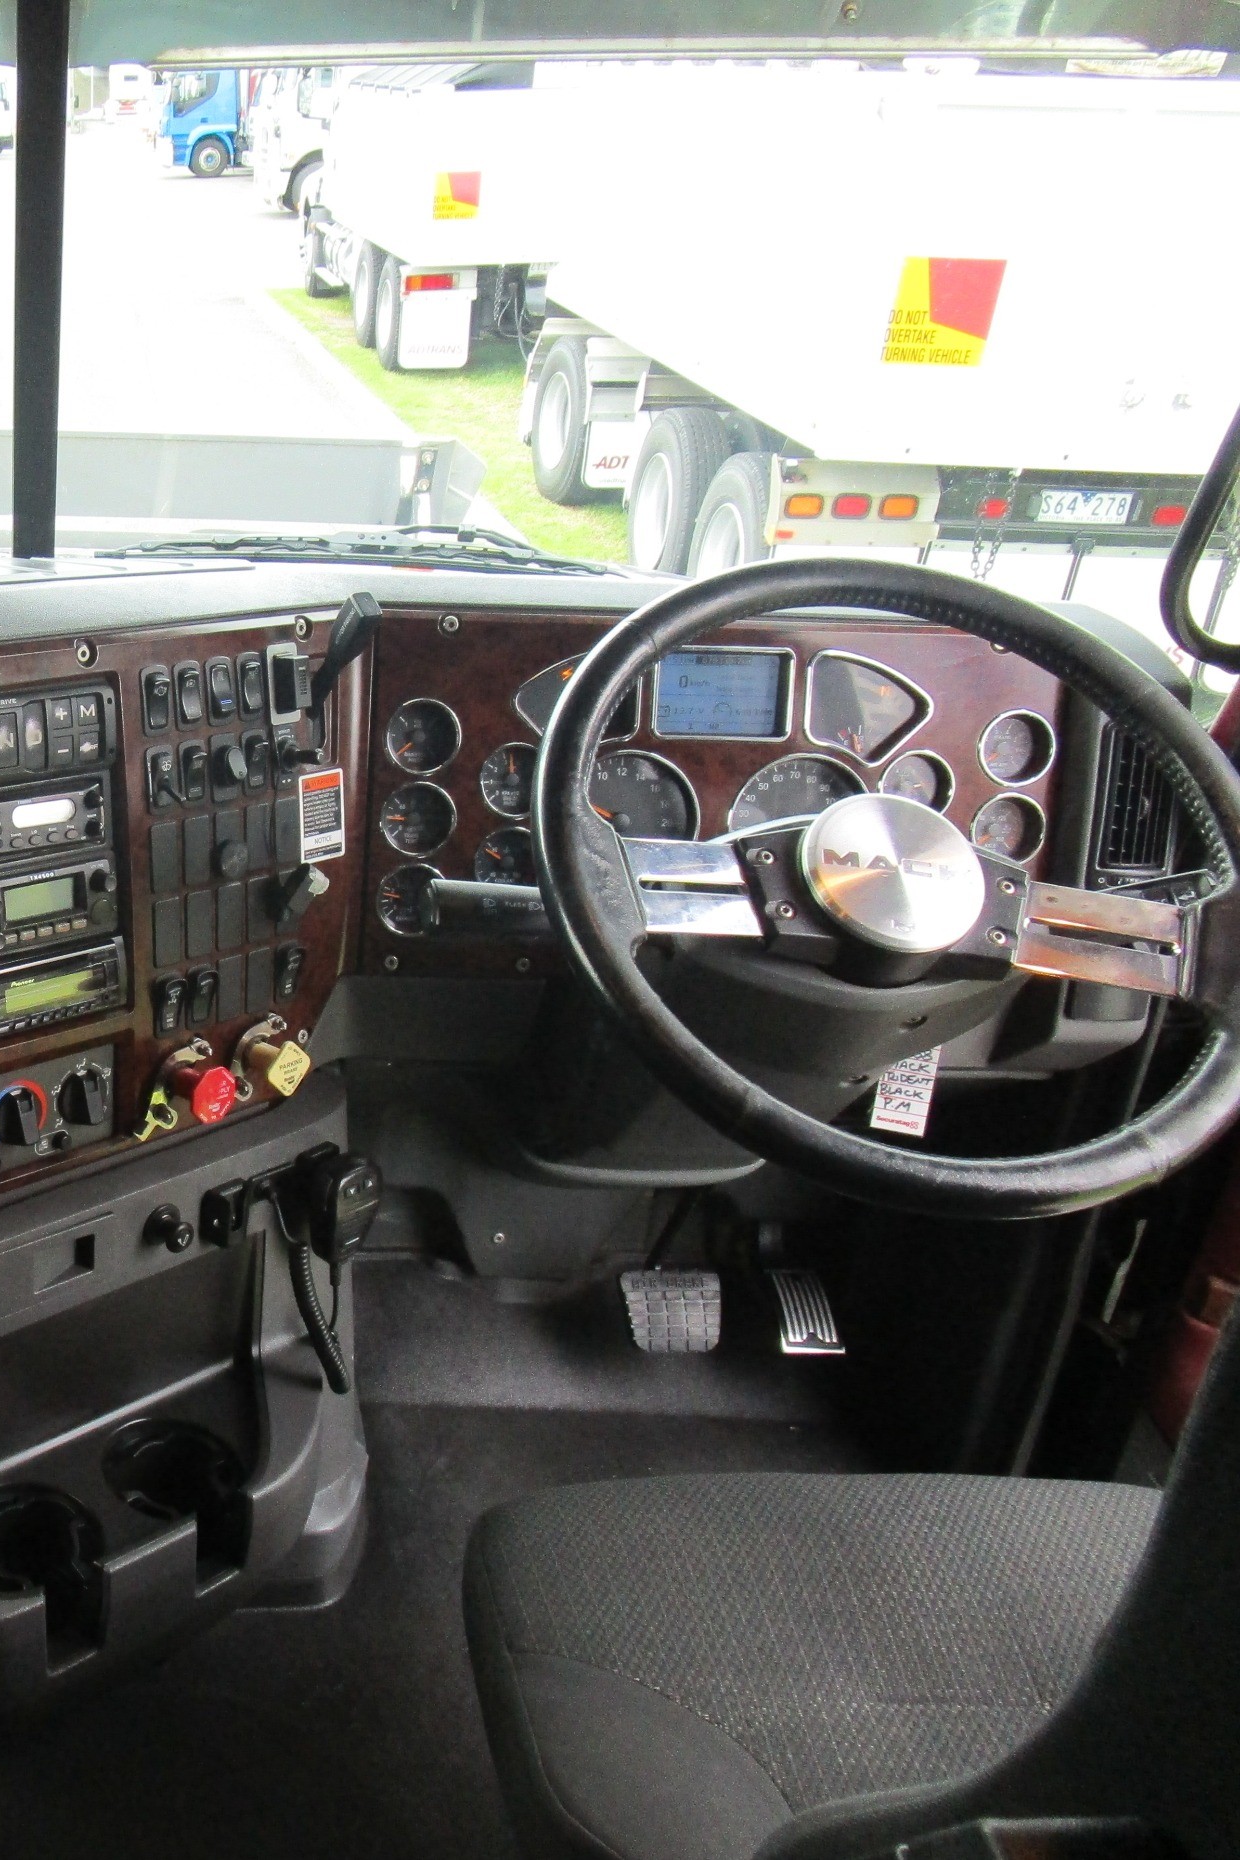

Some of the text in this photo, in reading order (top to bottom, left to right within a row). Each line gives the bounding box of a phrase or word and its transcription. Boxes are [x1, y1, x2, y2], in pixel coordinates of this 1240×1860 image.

[432, 204, 456, 212] OVERTAKE
[432, 212, 473, 220] TURNING VEHICLE
[888, 309, 928, 326] DO NOT
[883, 328, 937, 345] OVERTAKE
[880, 346, 972, 365] TURNING VEHICLE
[1041, 494, 1127, 517] S64 278
[80, 703, 96, 718] M
[772, 774, 784, 783] 60
[790, 771, 801, 779] 70
[806, 775, 817, 784] 80
[757, 782, 769, 791] 50
[820, 784, 831, 793] 90
[745, 794, 756, 802] 40
[739, 809, 750, 818] 30
[314, 835, 333, 845] NOTICE
[29, 872, 55, 881] TX4500
[10, 978, 35, 988] Pioneer
[279, 1058, 304, 1071] PARKING
[880, 1083, 924, 1100] BLACK
[876, 1115, 910, 1128] Securatag
